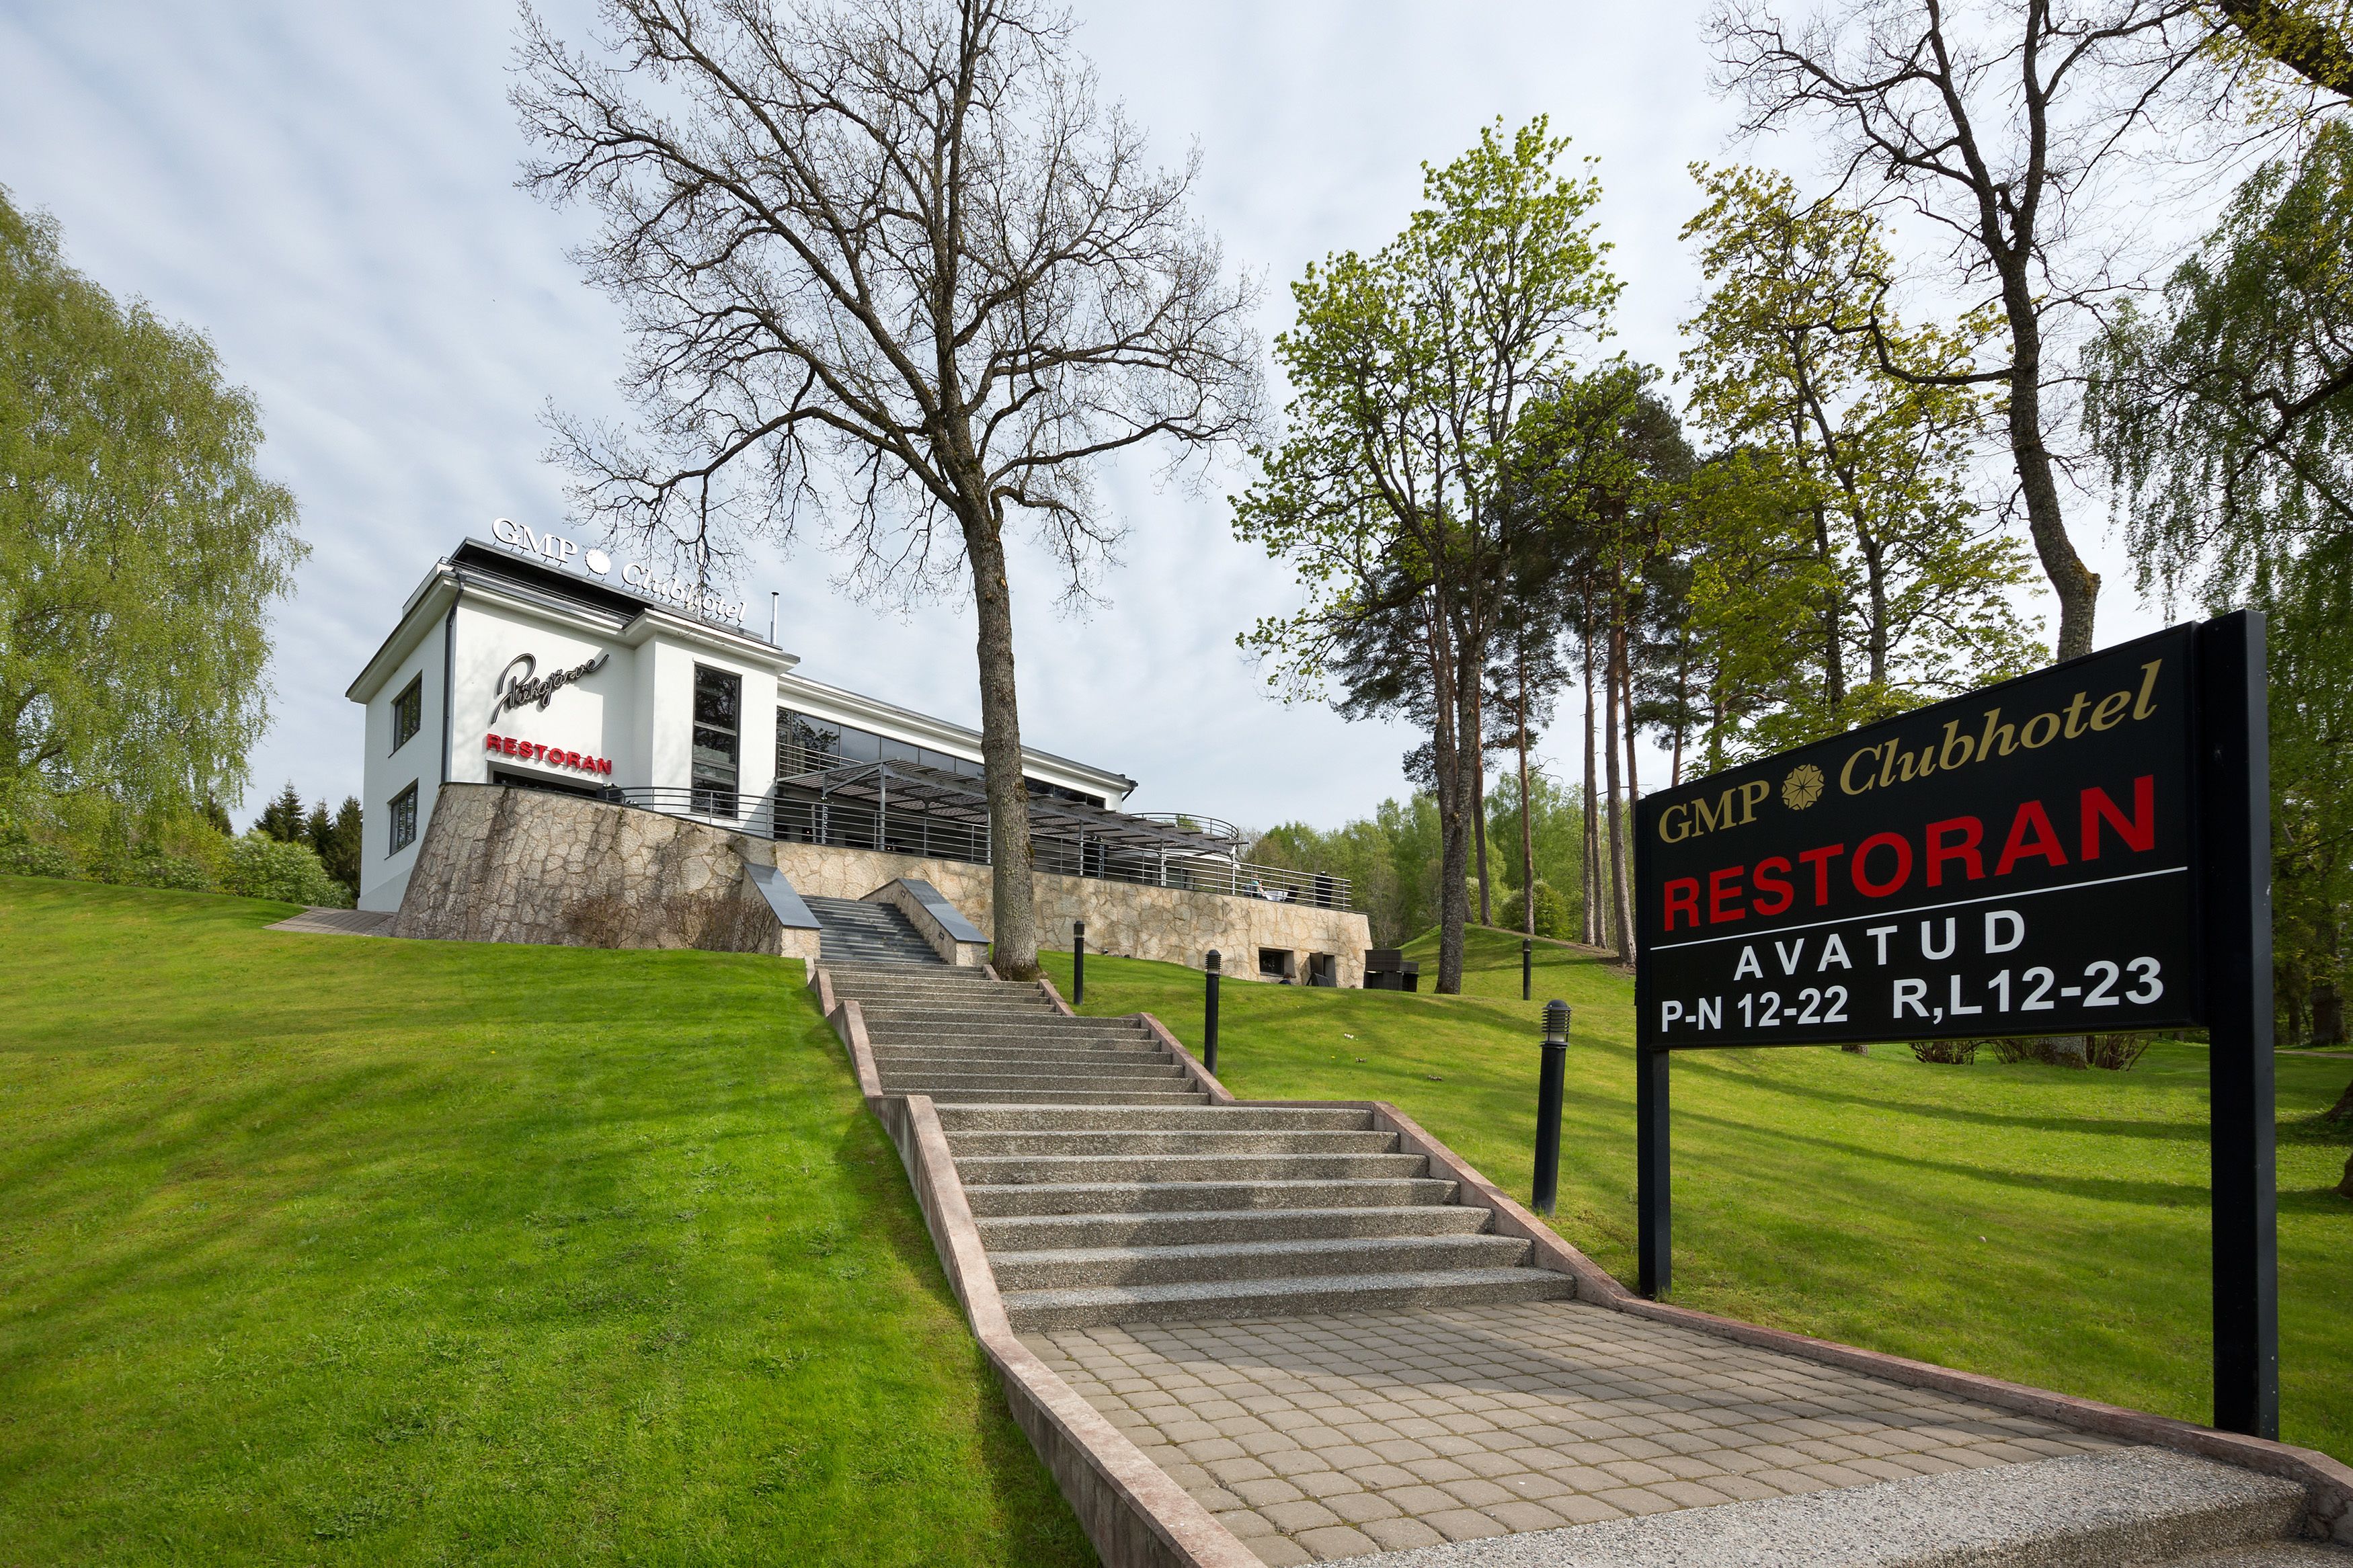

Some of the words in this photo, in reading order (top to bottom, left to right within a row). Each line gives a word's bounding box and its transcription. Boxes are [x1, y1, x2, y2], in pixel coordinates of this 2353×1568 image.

[492, 517, 578, 563] GMP
[622, 563, 748, 622] Clubhotel
[487, 733, 612, 775] RESTORAN
[1659, 780, 1770, 843] GMP
[1840, 658, 2163, 795] Clubhotel
[1664, 775, 2155, 932] RESTORAN
[1733, 909, 2025, 981] AVATUD
[1661, 996, 1722, 1033] P-N
[1738, 985, 1848, 1028] 12-22
